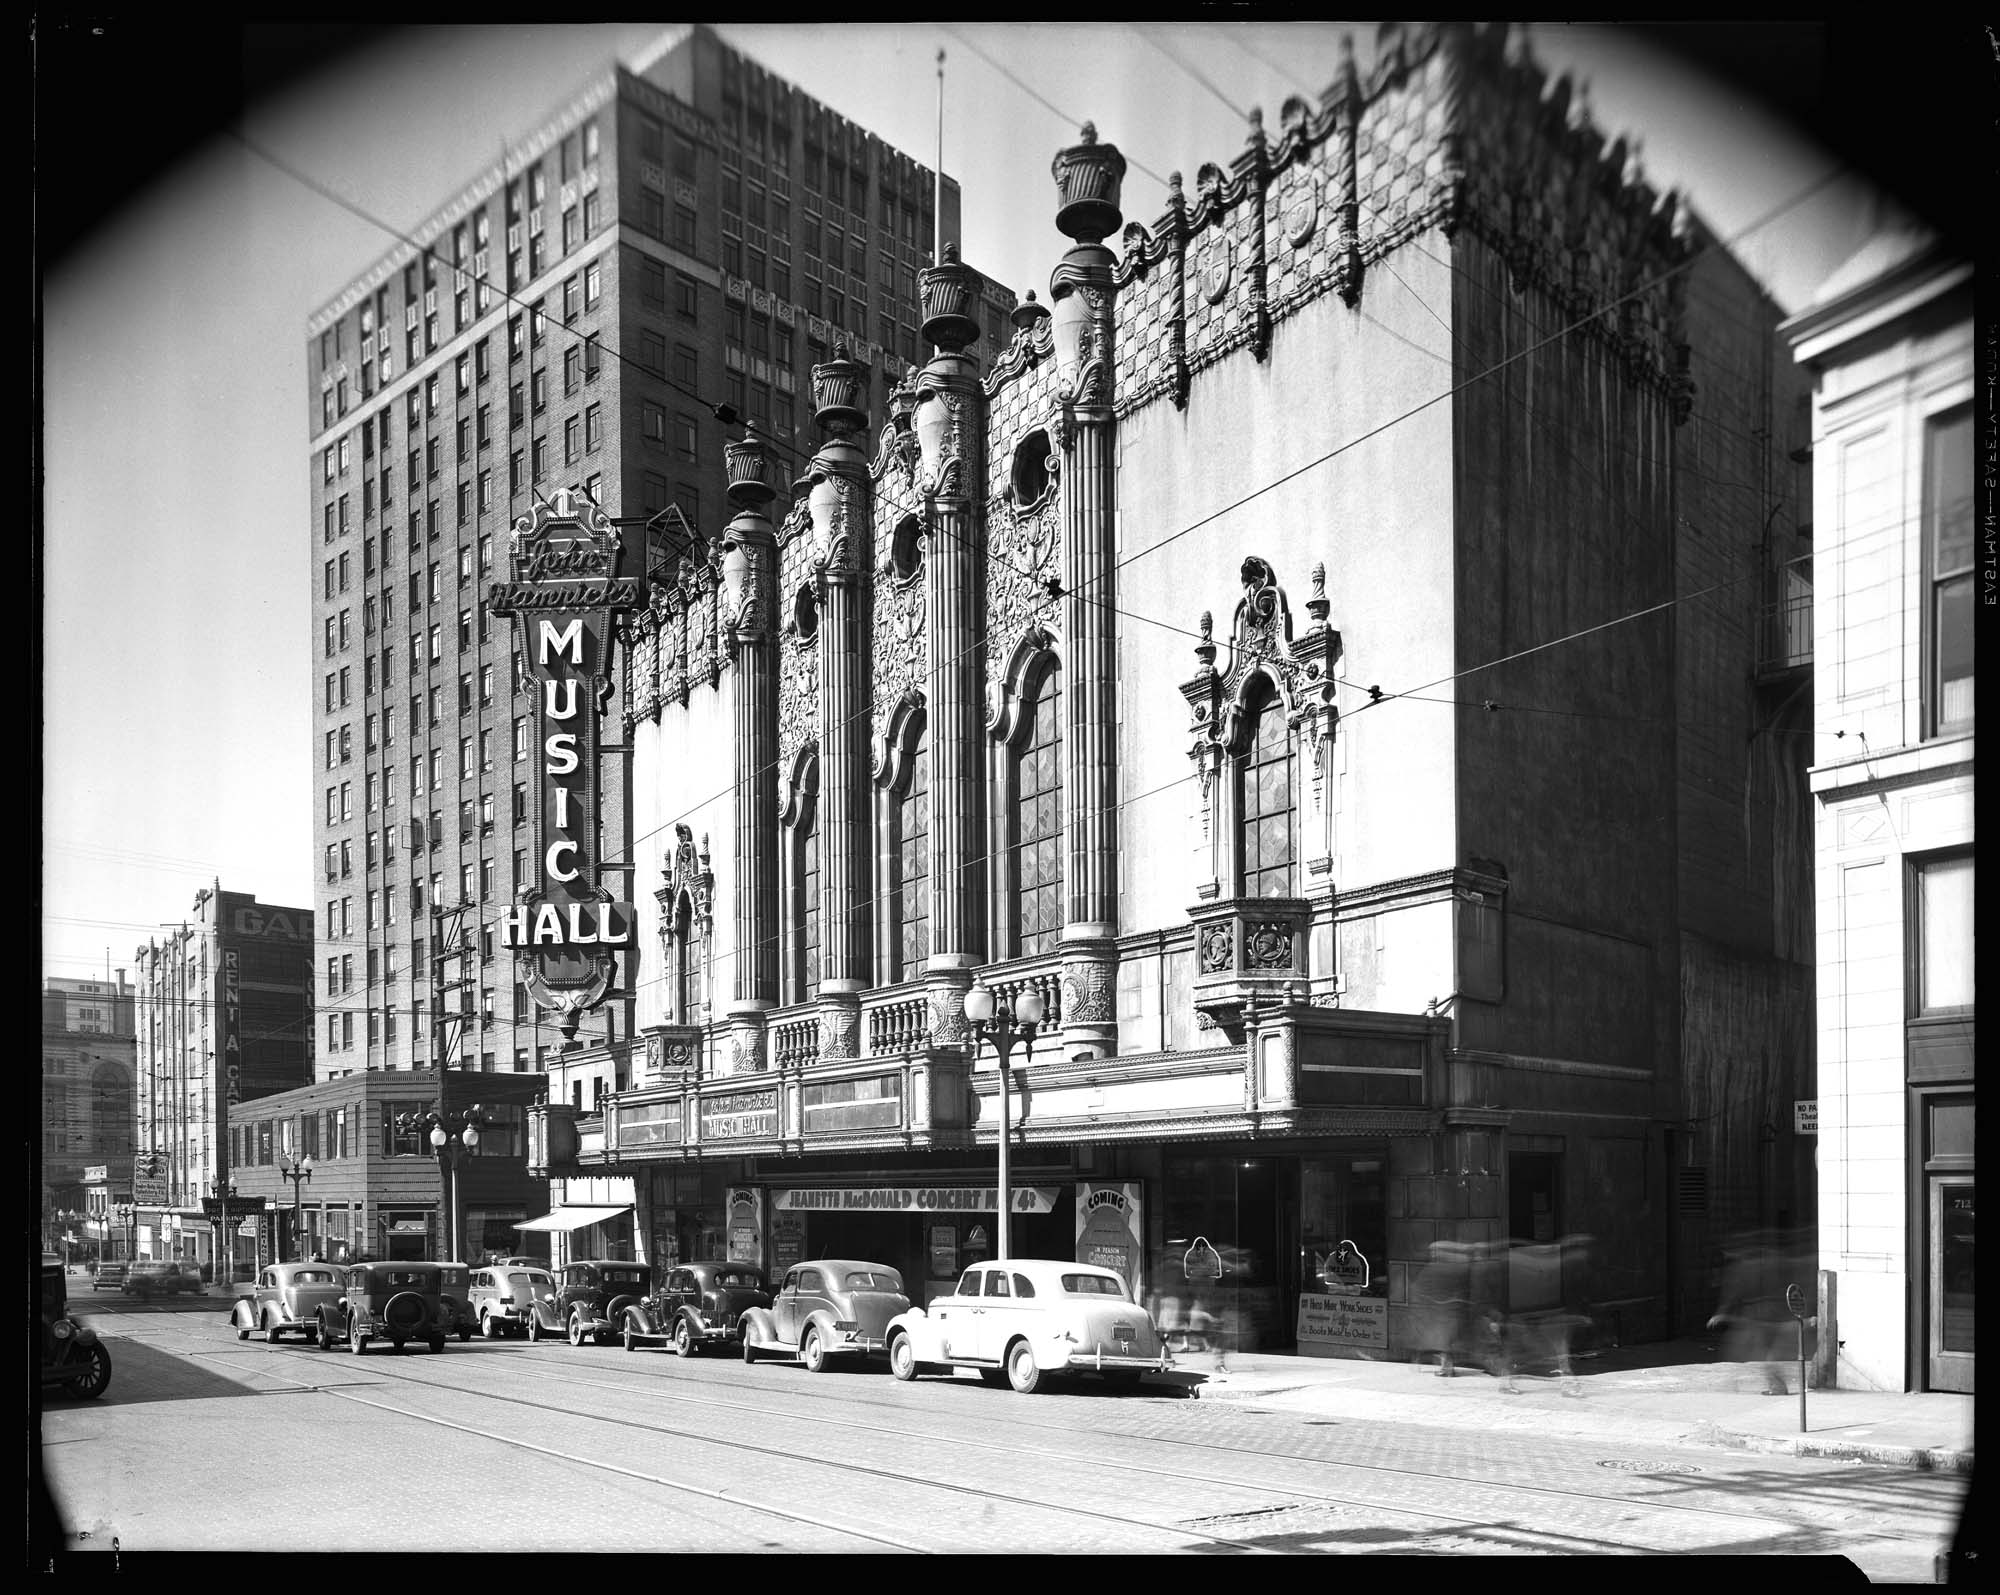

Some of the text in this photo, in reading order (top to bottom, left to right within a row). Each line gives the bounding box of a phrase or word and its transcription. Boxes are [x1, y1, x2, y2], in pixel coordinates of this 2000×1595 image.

[528, 539, 600, 582] John
[539, 619, 583, 882] MUSIC
[500, 903, 628, 946] HALL
[225, 951, 239, 1022] RENT
[226, 1033, 239, 1051] A
[1797, 1104, 1806, 1113] NO
[708, 1114, 769, 1138] MUSIC HALL
[789, 1190, 840, 1209] JEANETTE
[917, 1190, 981, 1210] CONCERT
[1088, 1191, 1125, 1210] COMING
[1088, 1251, 1127, 1267] CONCERT
